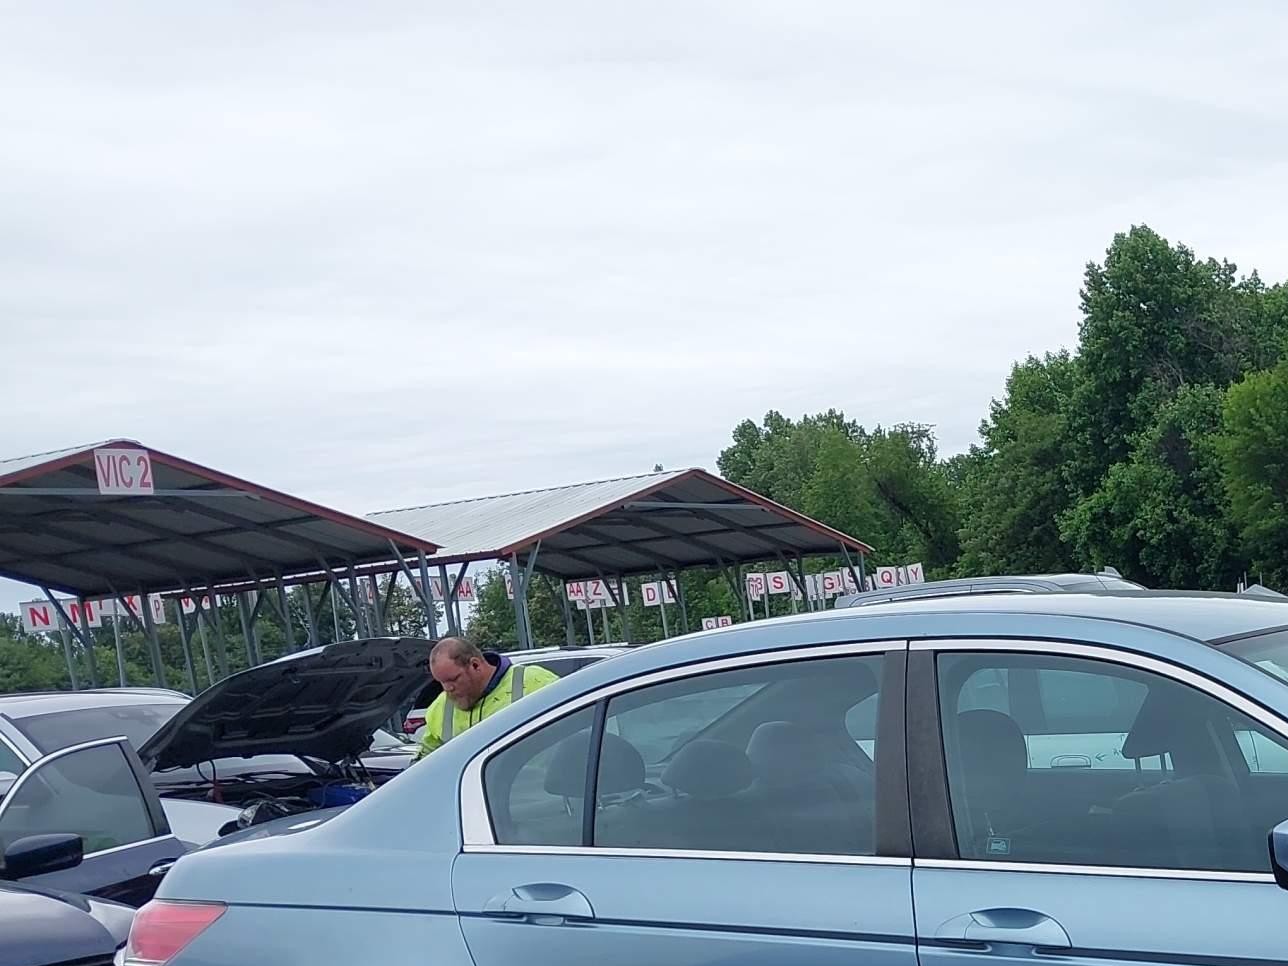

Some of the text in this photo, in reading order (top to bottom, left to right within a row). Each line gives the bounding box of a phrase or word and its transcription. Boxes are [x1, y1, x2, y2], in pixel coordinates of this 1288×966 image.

[96, 455, 152, 488] VIC 2
[880, 570, 893, 584] Q
[910, 567, 918, 581] Y
[457, 582, 473, 597] AA
[591, 581, 602, 596] Z
[772, 576, 784, 589] S
[823, 576, 835, 590] G
[569, 583, 584, 597] AA
[645, 587, 656, 602] D
[29, 606, 51, 627] N
